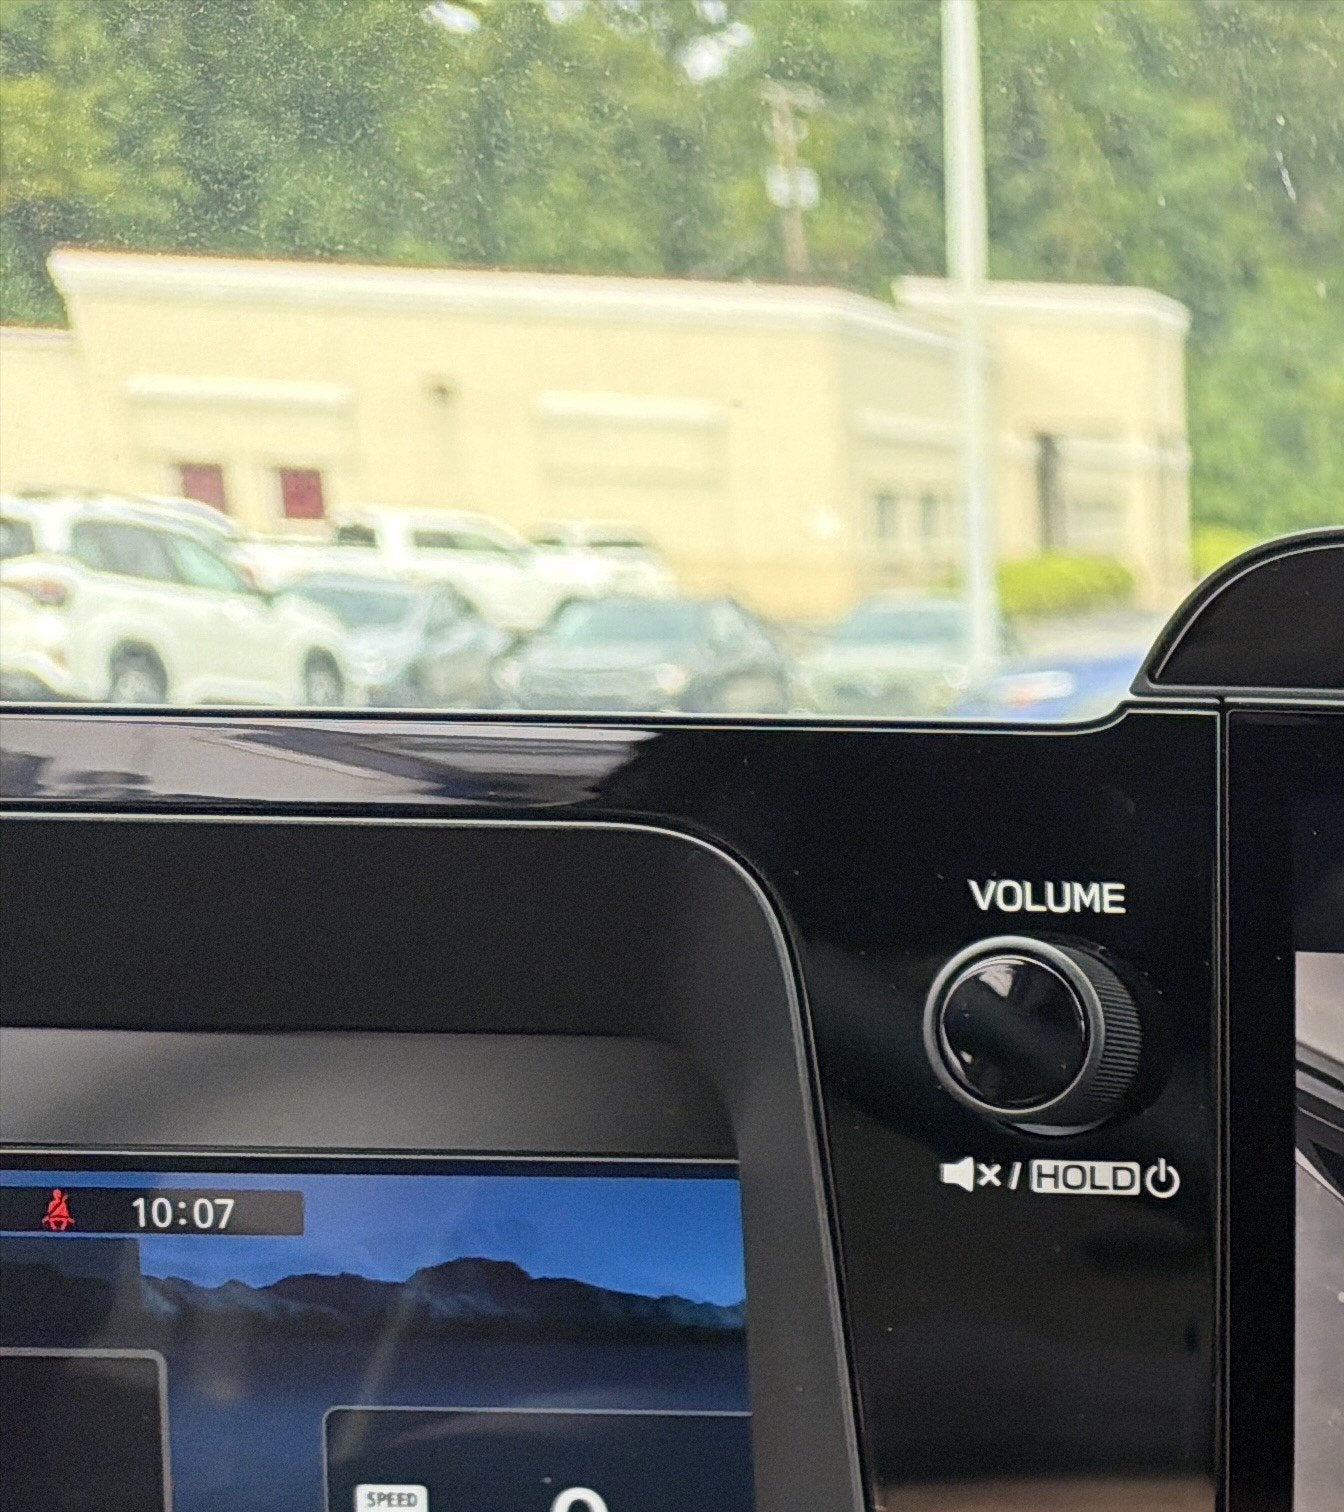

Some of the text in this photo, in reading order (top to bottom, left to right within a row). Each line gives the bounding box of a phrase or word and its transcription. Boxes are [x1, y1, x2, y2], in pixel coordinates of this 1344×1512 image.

[967, 879, 1127, 914] VOLUME
[1036, 1164, 1136, 1190] HOLD
[131, 1197, 236, 1230] 10:07
[366, 1491, 419, 1508] SPEED
